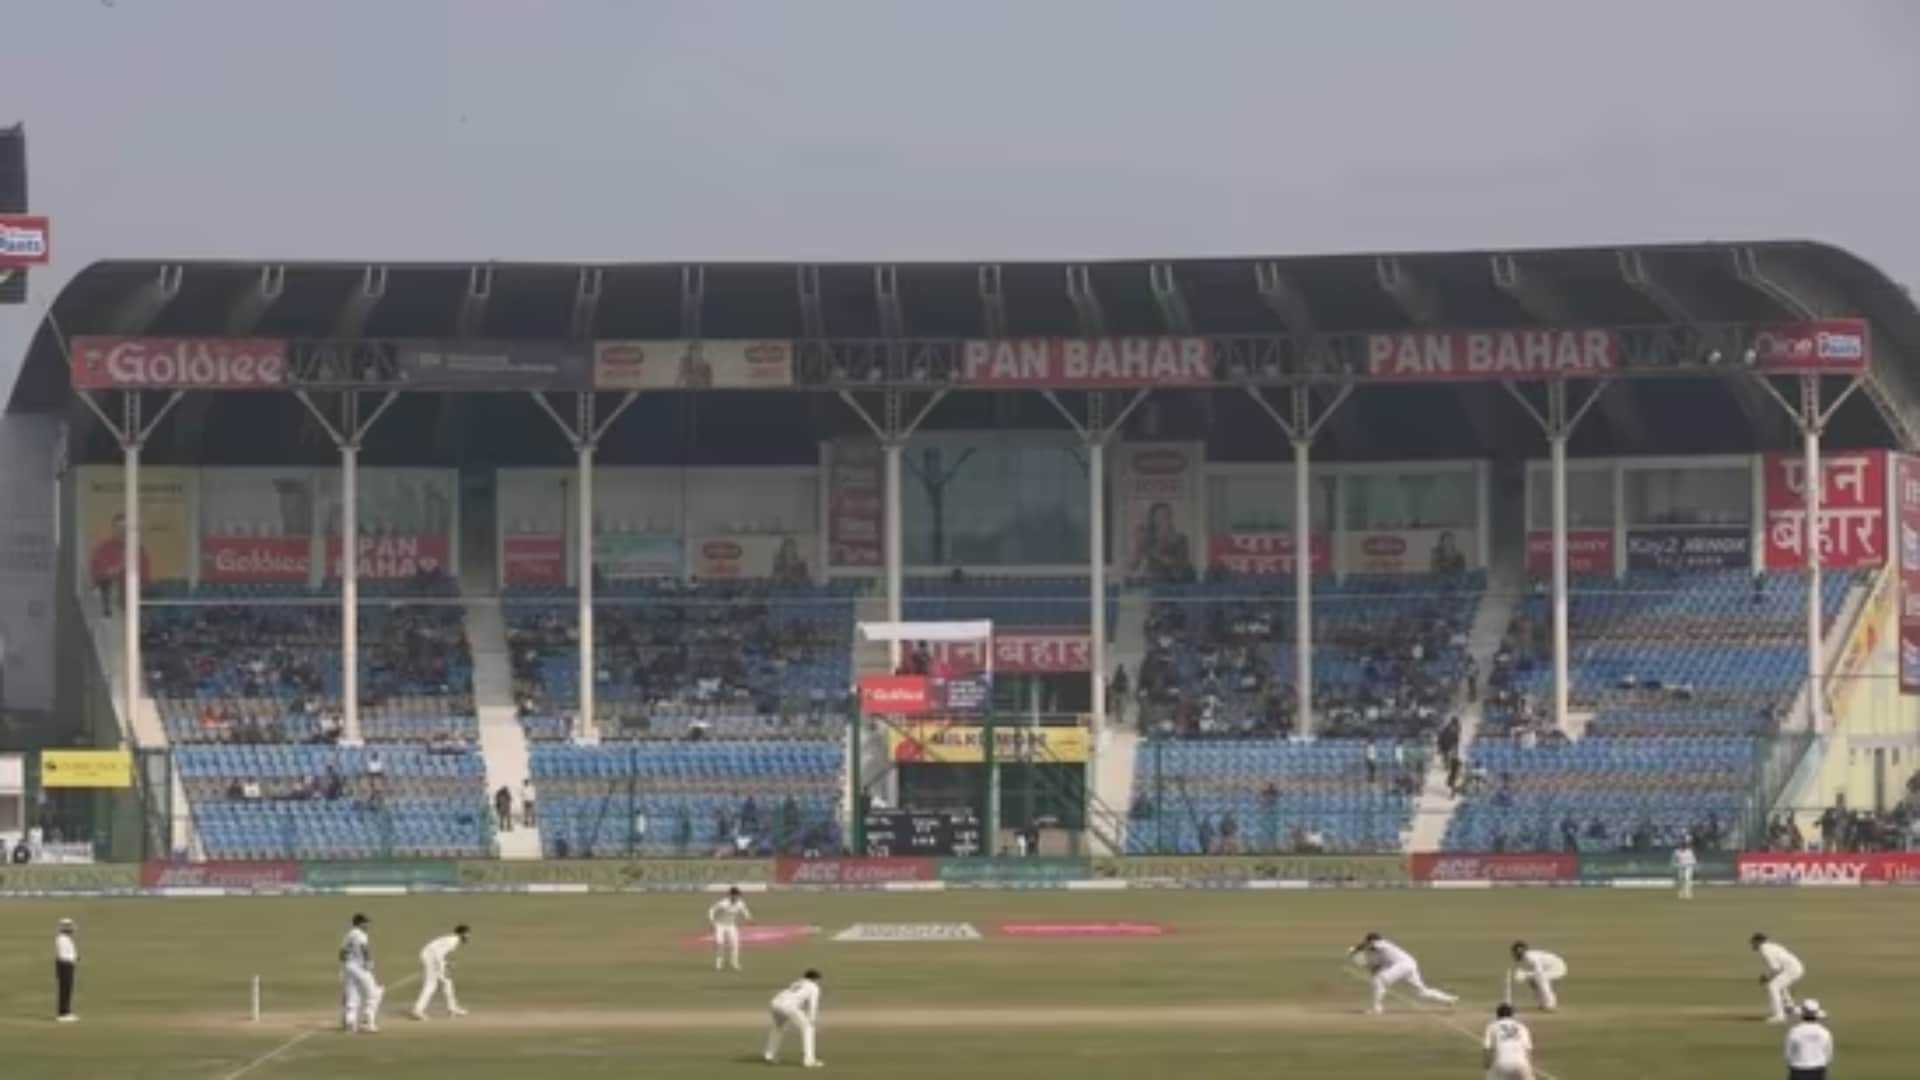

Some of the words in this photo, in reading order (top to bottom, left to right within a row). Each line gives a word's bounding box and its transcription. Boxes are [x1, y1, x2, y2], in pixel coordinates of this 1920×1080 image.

[107, 342, 282, 384] Goldiee
[964, 339, 1047, 379] PAN
[1064, 338, 1209, 379] BAHAR
[1370, 334, 1452, 374] PAN
[1468, 328, 1611, 371] BAHAR
[359, 537, 417, 557] PAN
